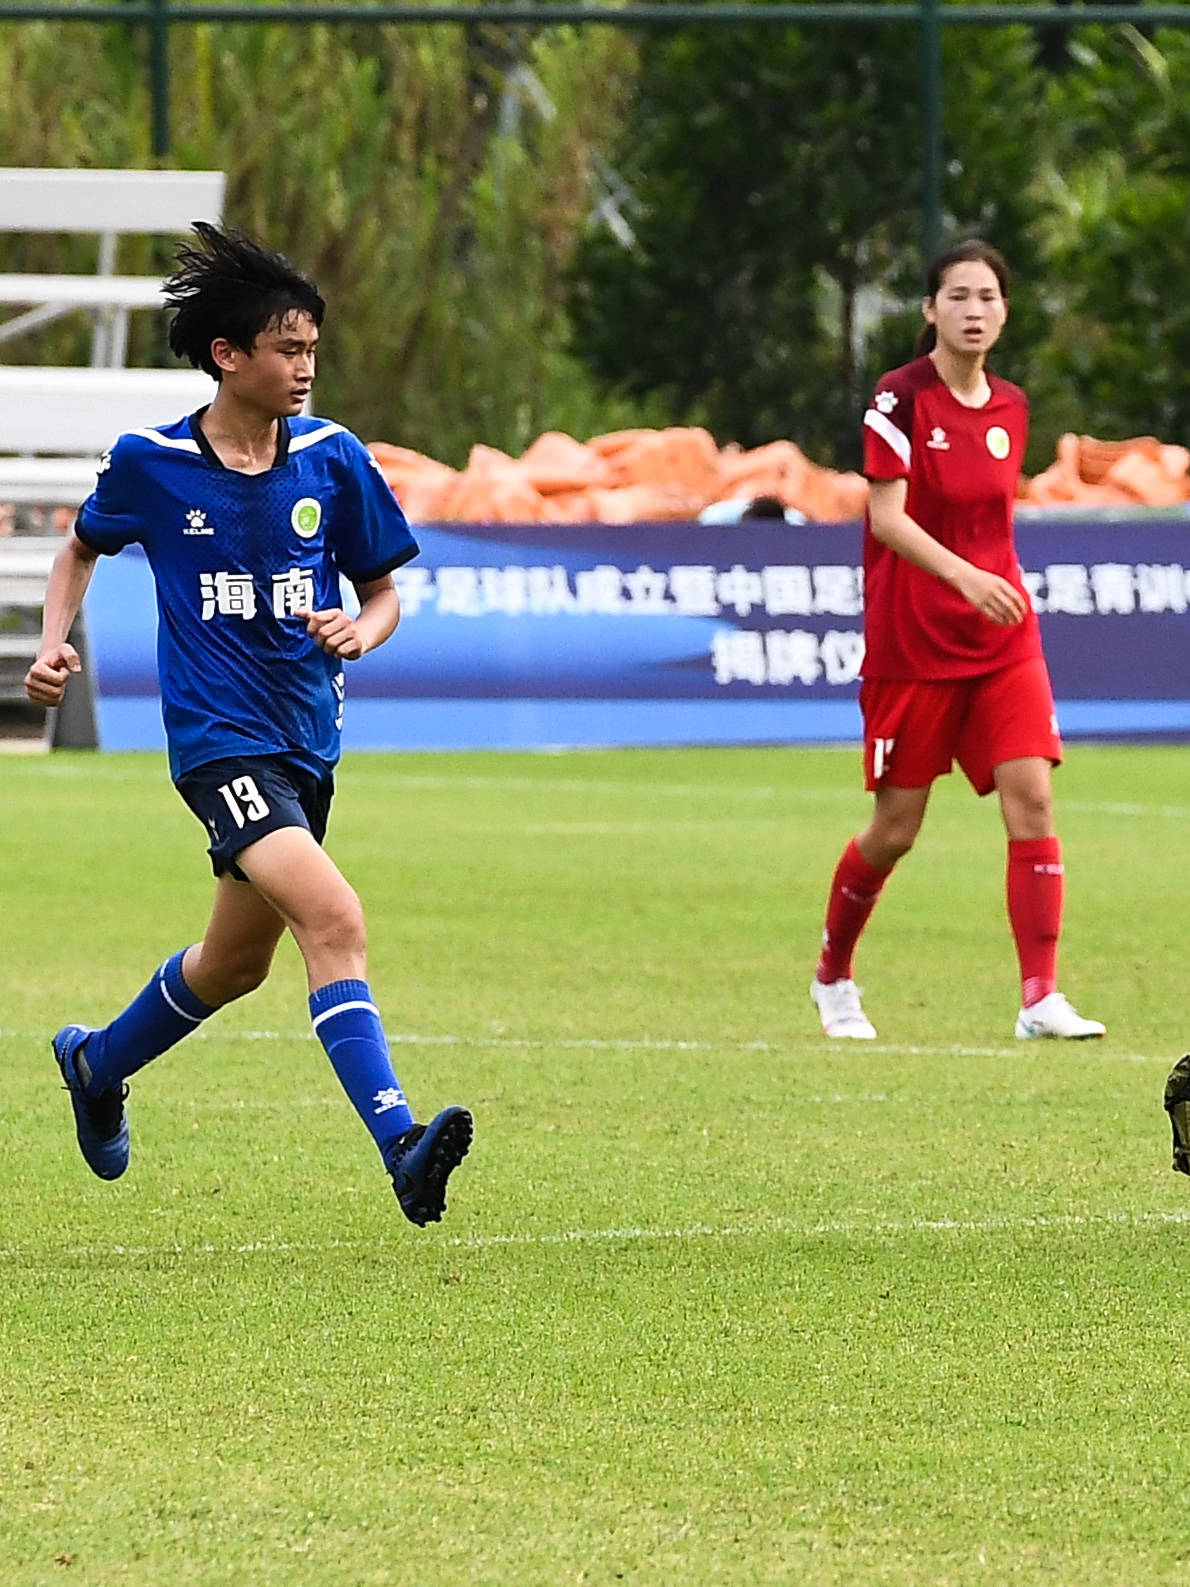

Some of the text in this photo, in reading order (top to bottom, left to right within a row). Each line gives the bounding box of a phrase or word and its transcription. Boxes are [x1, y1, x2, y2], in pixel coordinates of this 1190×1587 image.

[200, 567, 314, 621] 海南
[394, 565, 864, 617] 子足球队成立暨中国足
[217, 775, 270, 829] 13
